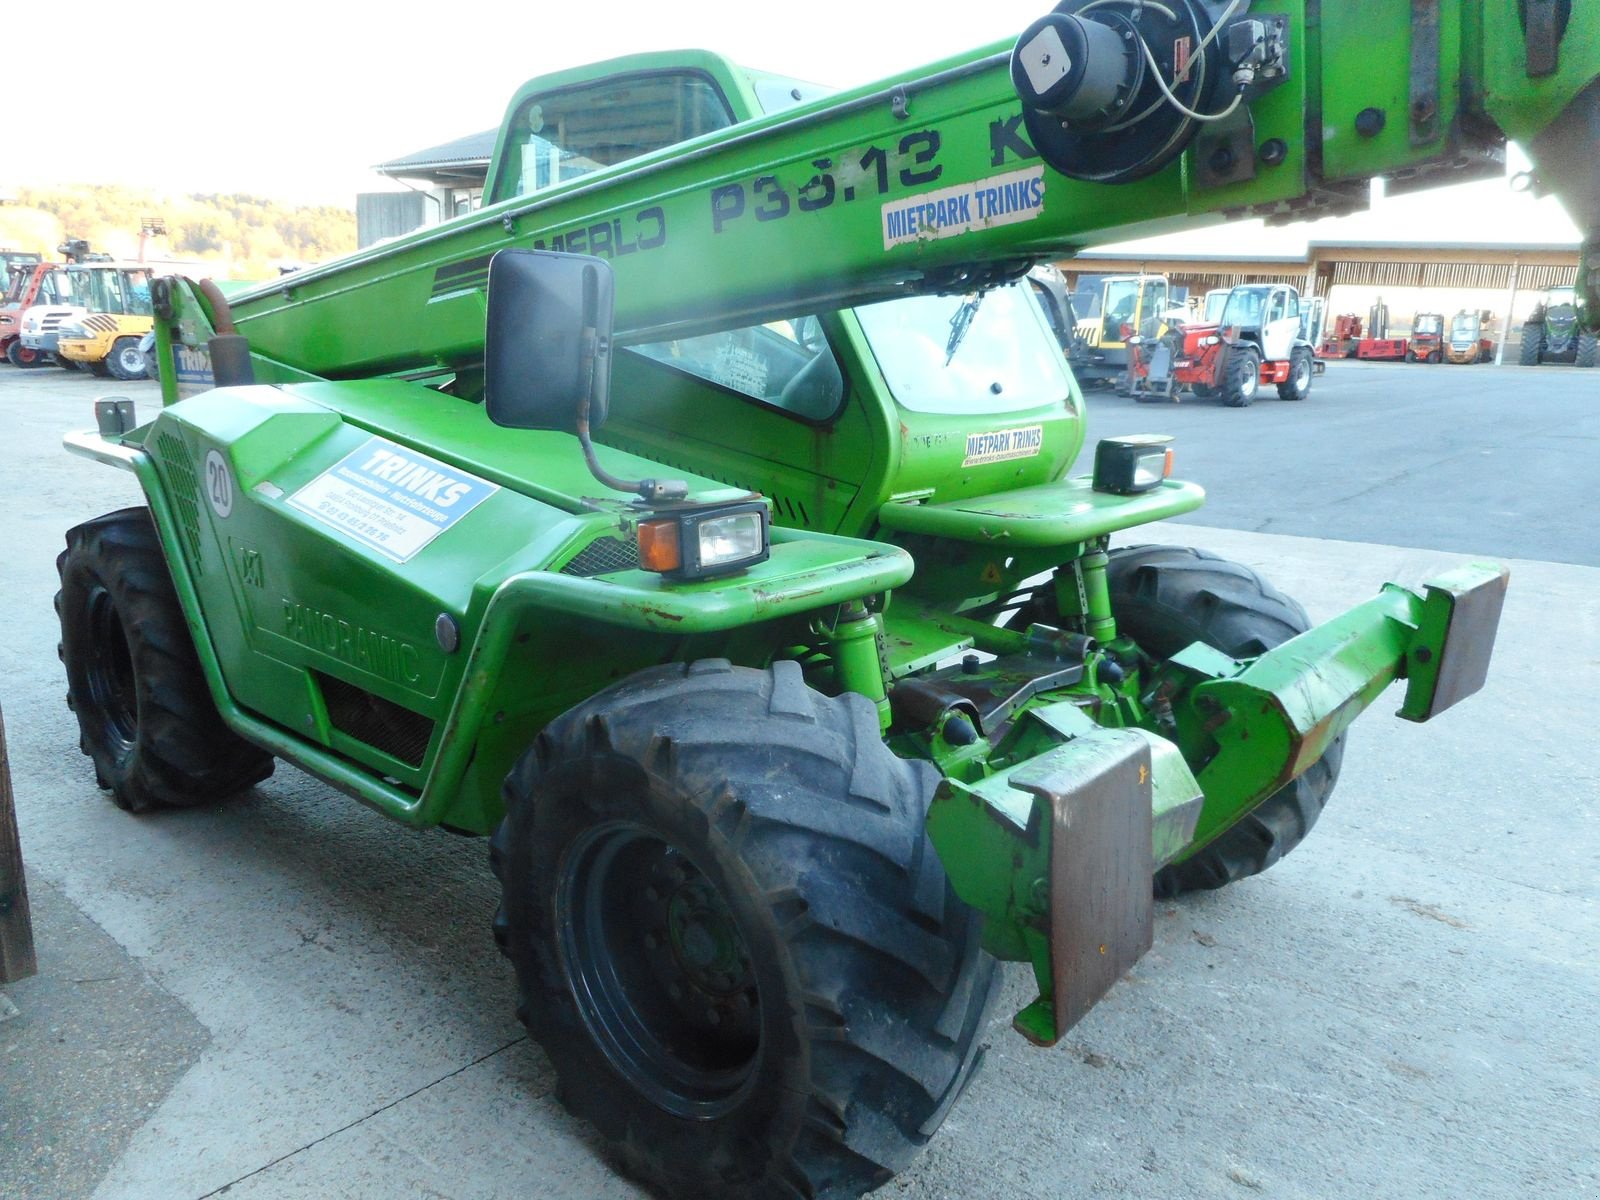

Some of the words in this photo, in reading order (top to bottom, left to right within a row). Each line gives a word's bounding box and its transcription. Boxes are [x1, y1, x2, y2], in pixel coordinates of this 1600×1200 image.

[990, 114, 1040, 167] K
[887, 197, 971, 239] MIETPARK
[975, 177, 1042, 220] TRINKS
[178, 350, 213, 371] TRIN
[967, 433, 1010, 456] MIETPARK
[1013, 429, 1041, 448] TRINKS
[209, 461, 228, 507] 20
[361, 448, 473, 508] TRINKS
